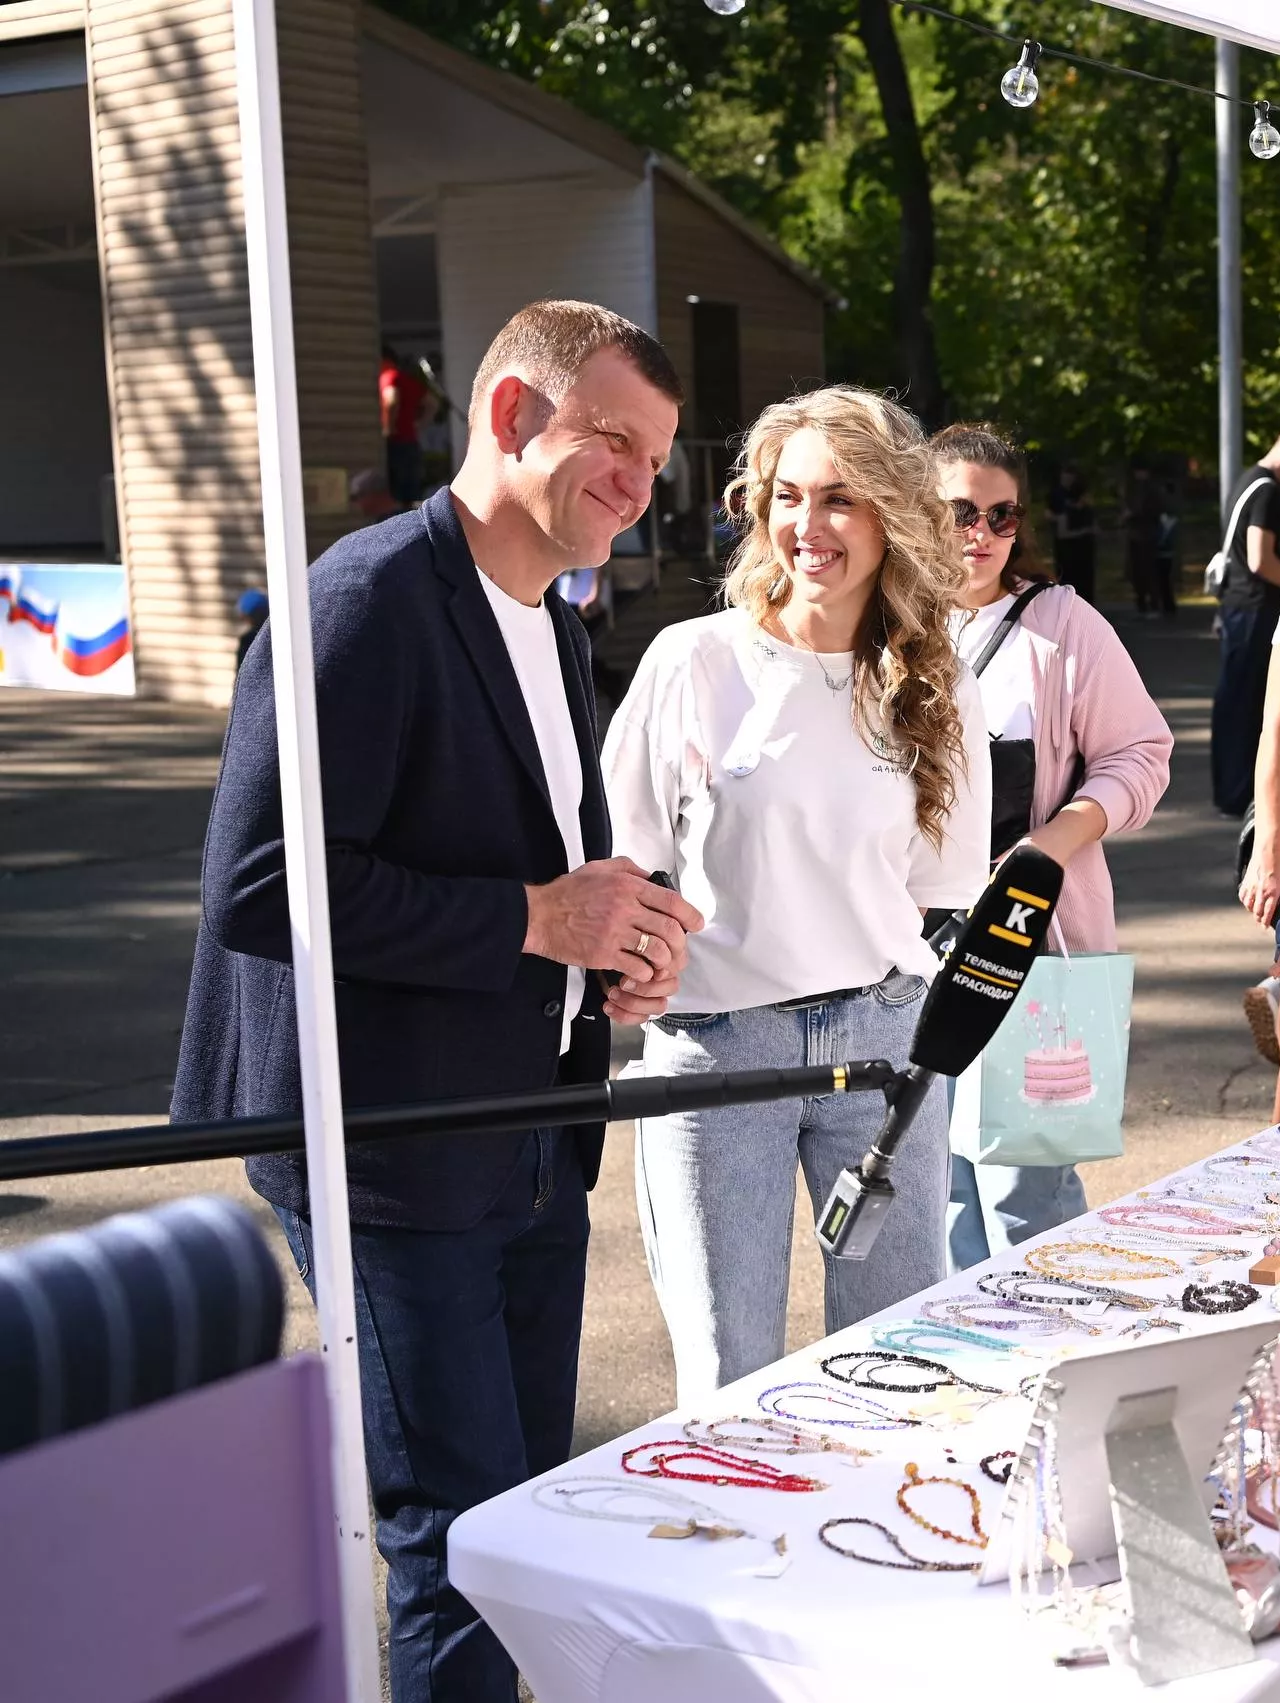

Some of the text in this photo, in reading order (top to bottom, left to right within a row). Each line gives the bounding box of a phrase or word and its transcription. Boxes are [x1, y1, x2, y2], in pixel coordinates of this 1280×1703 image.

[1005, 902, 1036, 934] К
[964, 952, 1025, 981] телеканал
[952, 972, 1014, 1000] КРАСНОДАР
